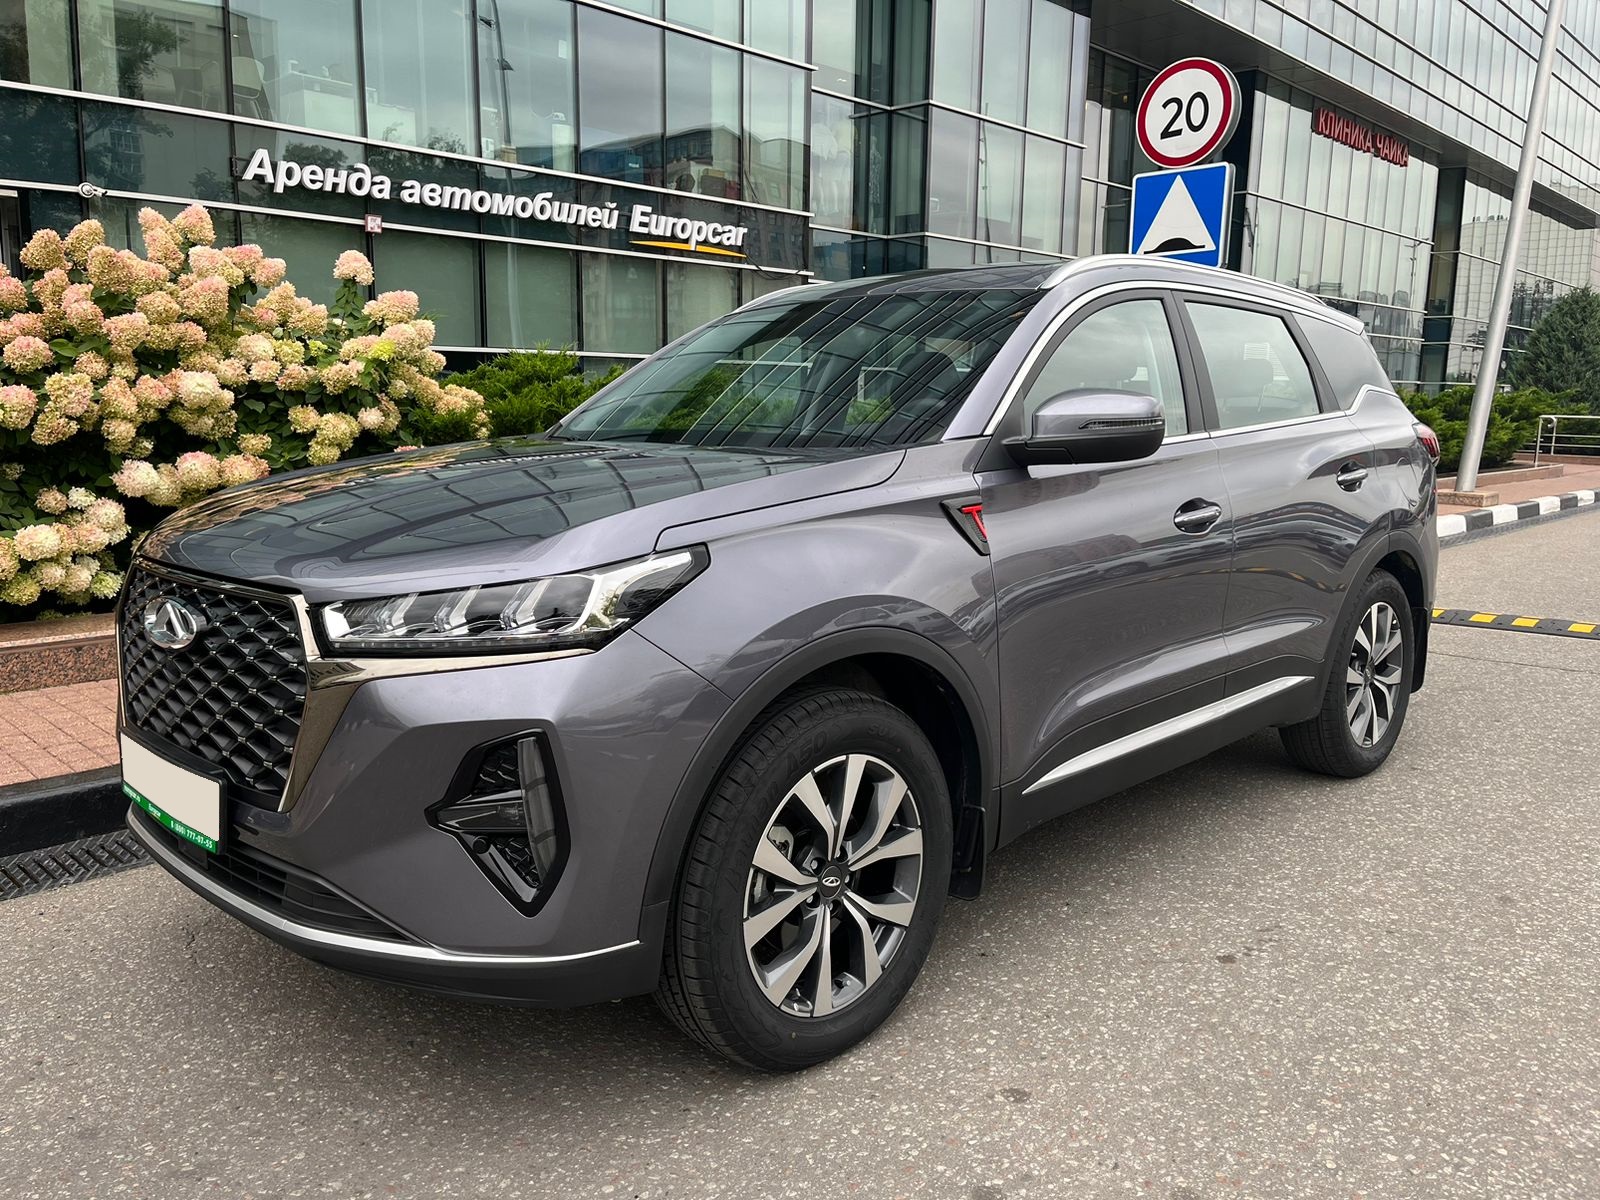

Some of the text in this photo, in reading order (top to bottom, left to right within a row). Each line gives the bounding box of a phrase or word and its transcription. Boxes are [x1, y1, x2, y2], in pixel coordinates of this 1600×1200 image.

[1160, 92, 1209, 139] 20
[1318, 107, 1409, 168] КЛИНИКА ЧАЙКА
[242, 148, 748, 251] Аренда автомобилей Europcar
